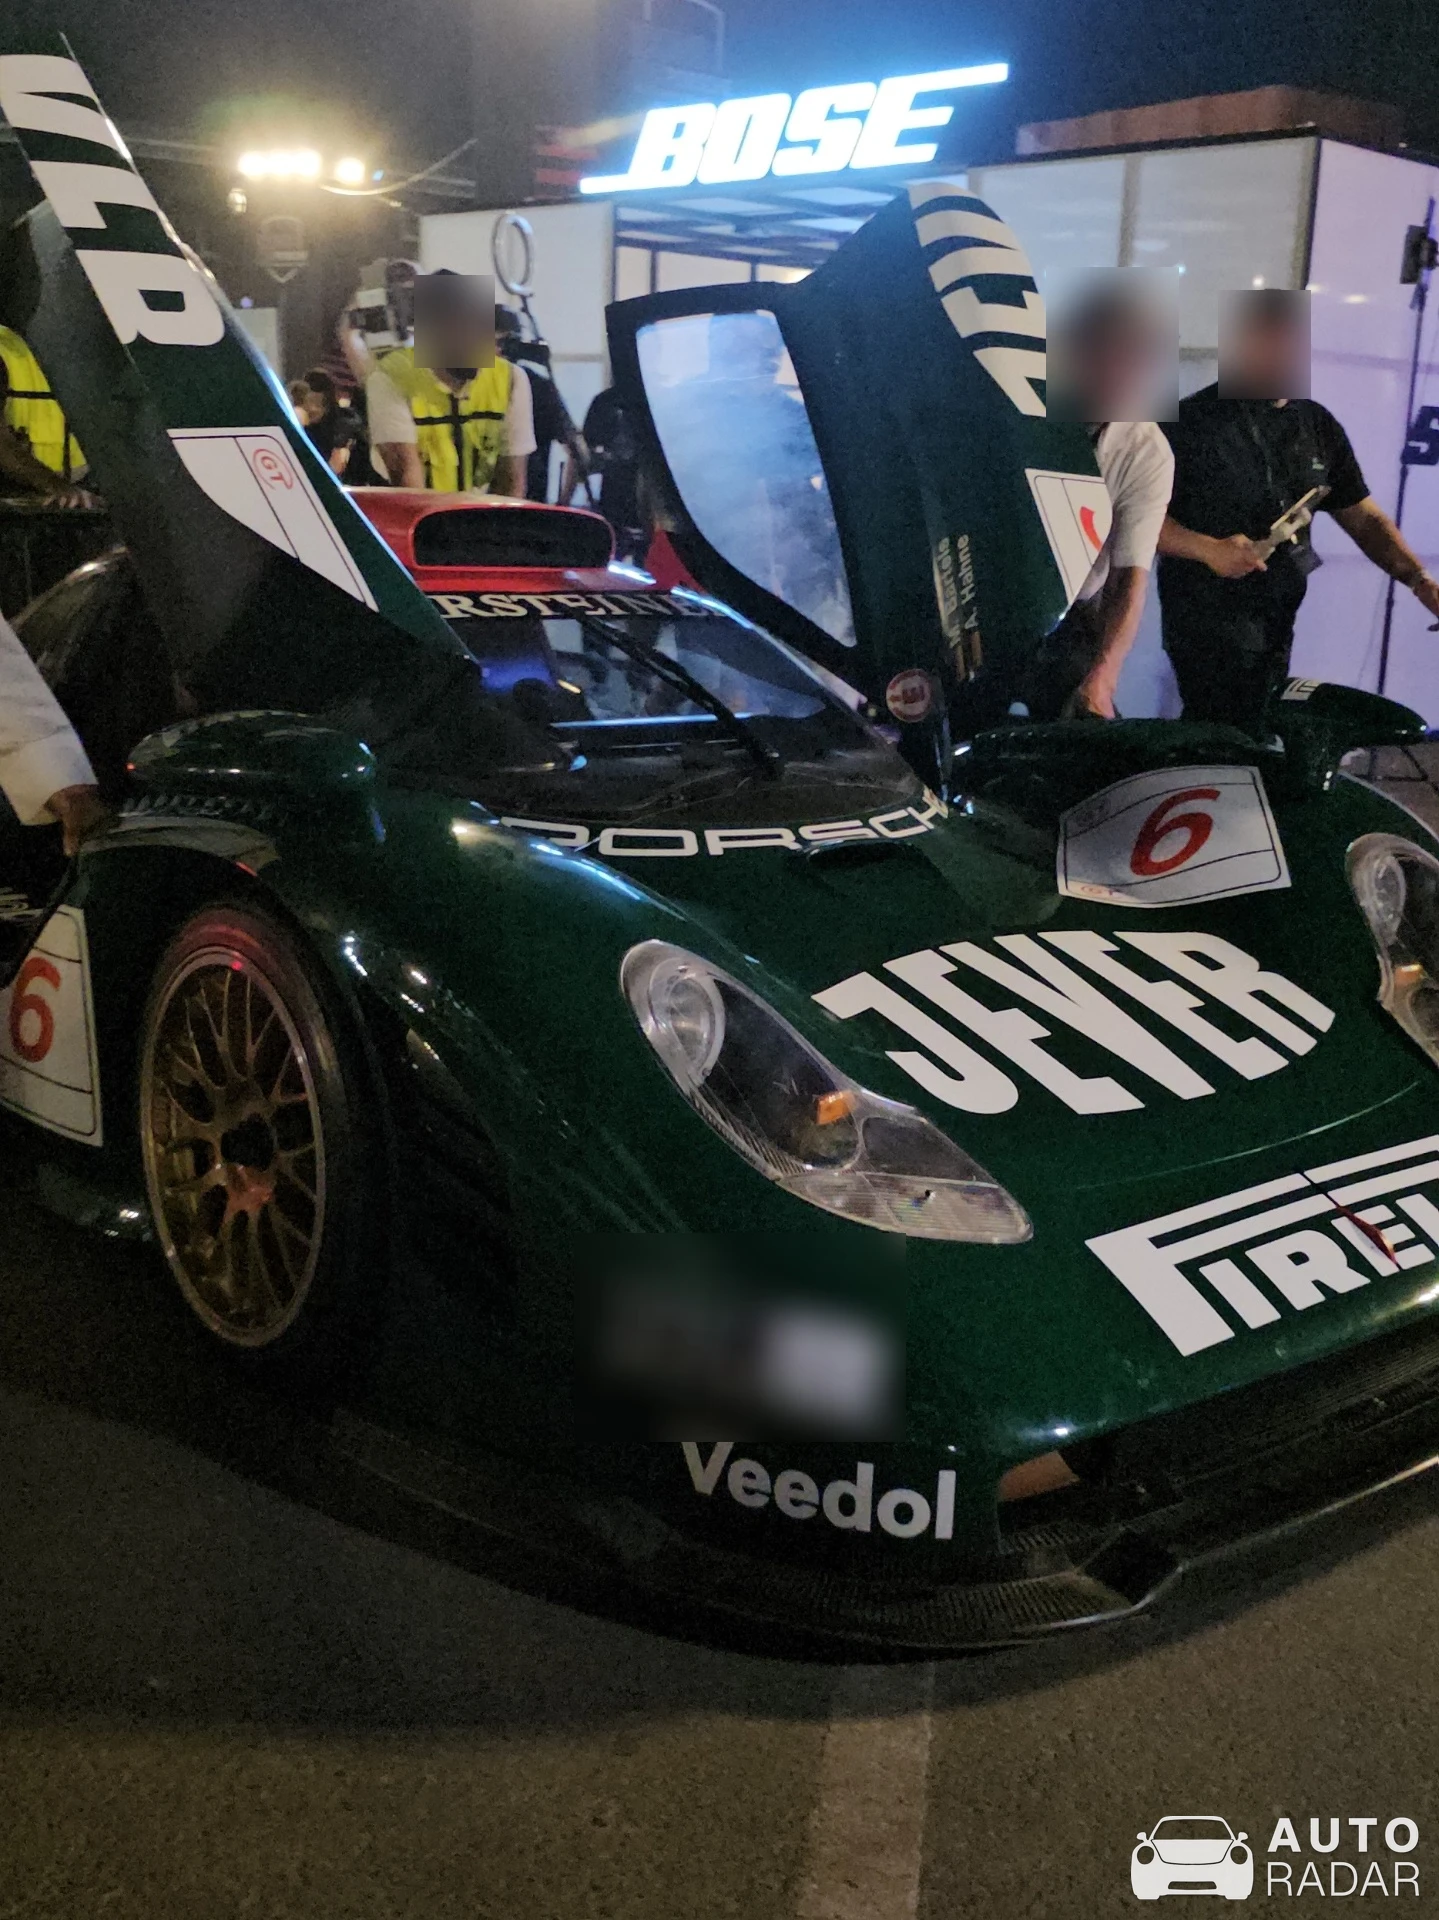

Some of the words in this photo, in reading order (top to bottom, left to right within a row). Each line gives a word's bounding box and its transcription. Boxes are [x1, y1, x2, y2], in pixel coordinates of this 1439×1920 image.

[579, 62, 1008, 194] BOSE
[957, 533, 976, 606] Hahne
[1130, 788, 1221, 876] 6
[10, 957, 62, 1063] 6
[811, 930, 1336, 1114] JEVER
[681, 1441, 957, 1540] Veedol
